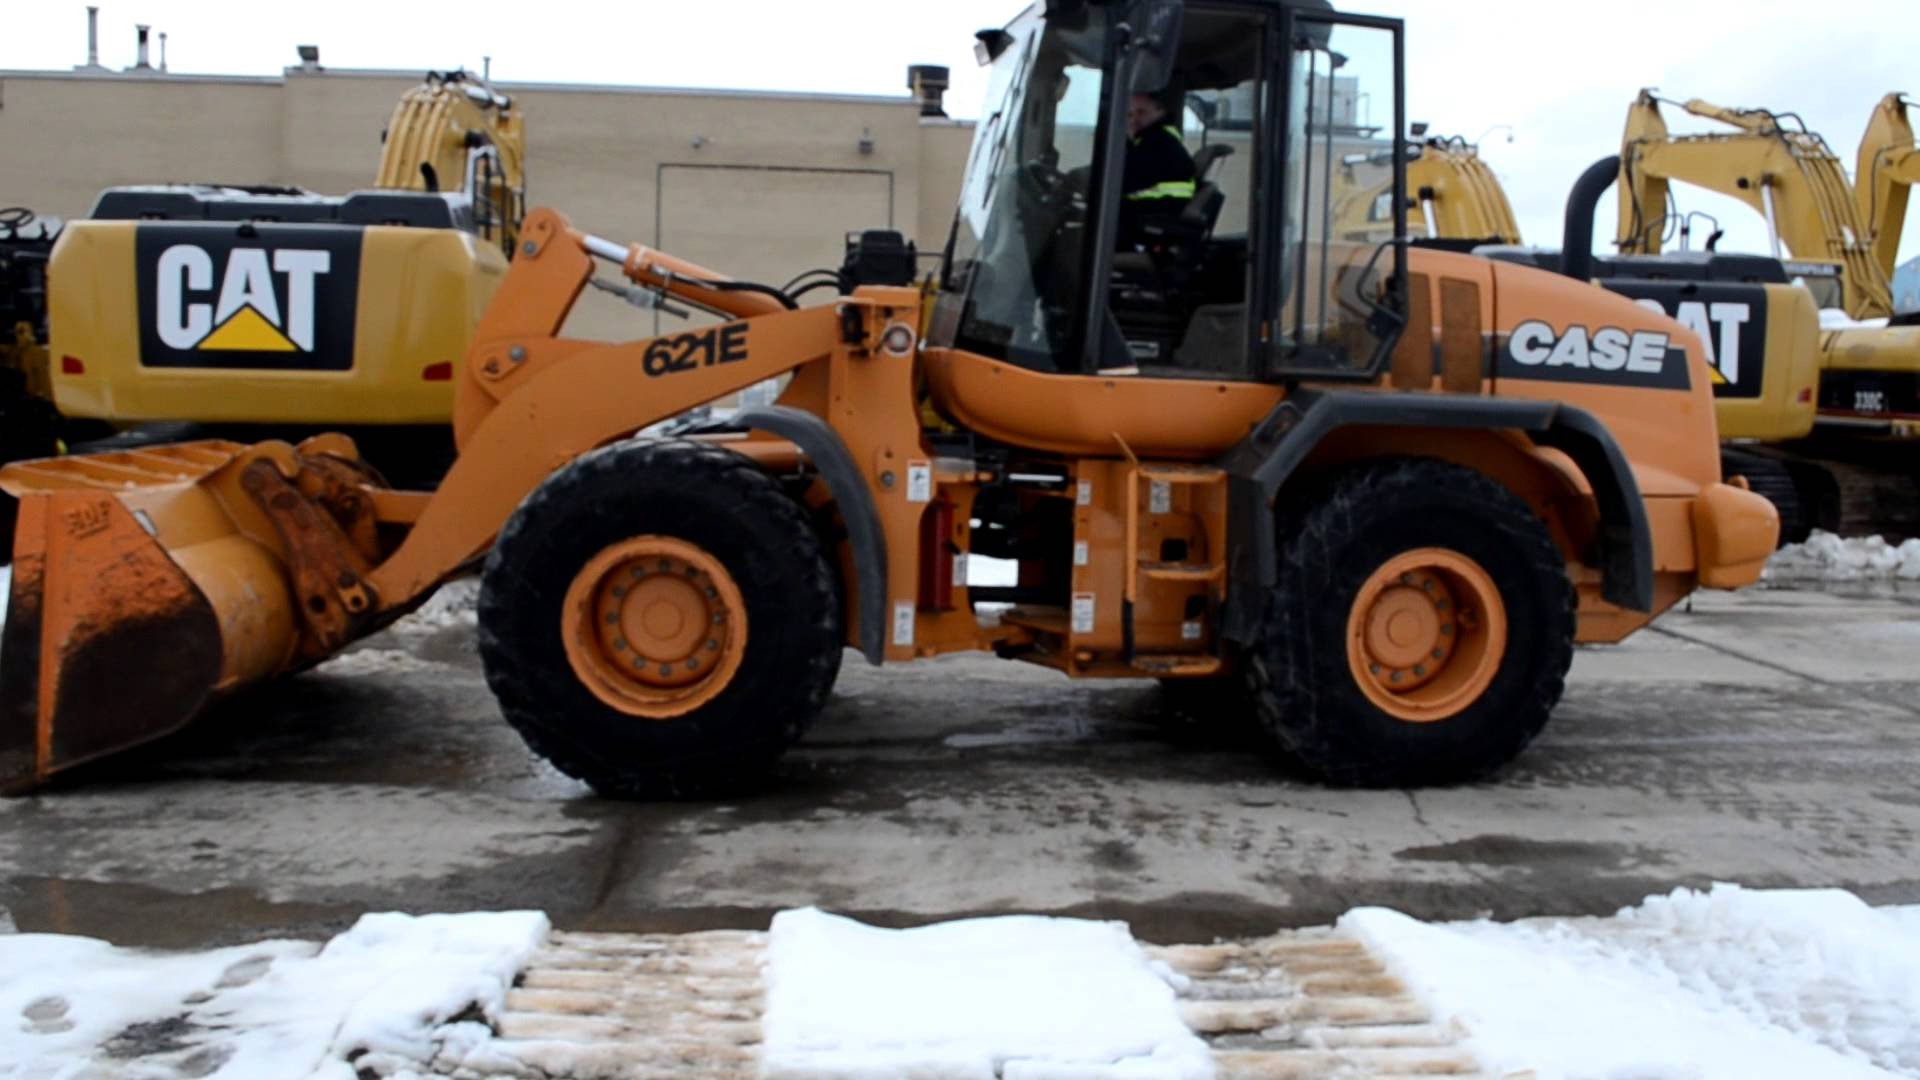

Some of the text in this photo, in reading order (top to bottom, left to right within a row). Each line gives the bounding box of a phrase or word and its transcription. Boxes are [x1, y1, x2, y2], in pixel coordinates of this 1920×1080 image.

[157, 244, 331, 352] CAT
[643, 323, 749, 377] 621E
[1509, 321, 1669, 374] CASE
[1633, 299, 1750, 384] AT
